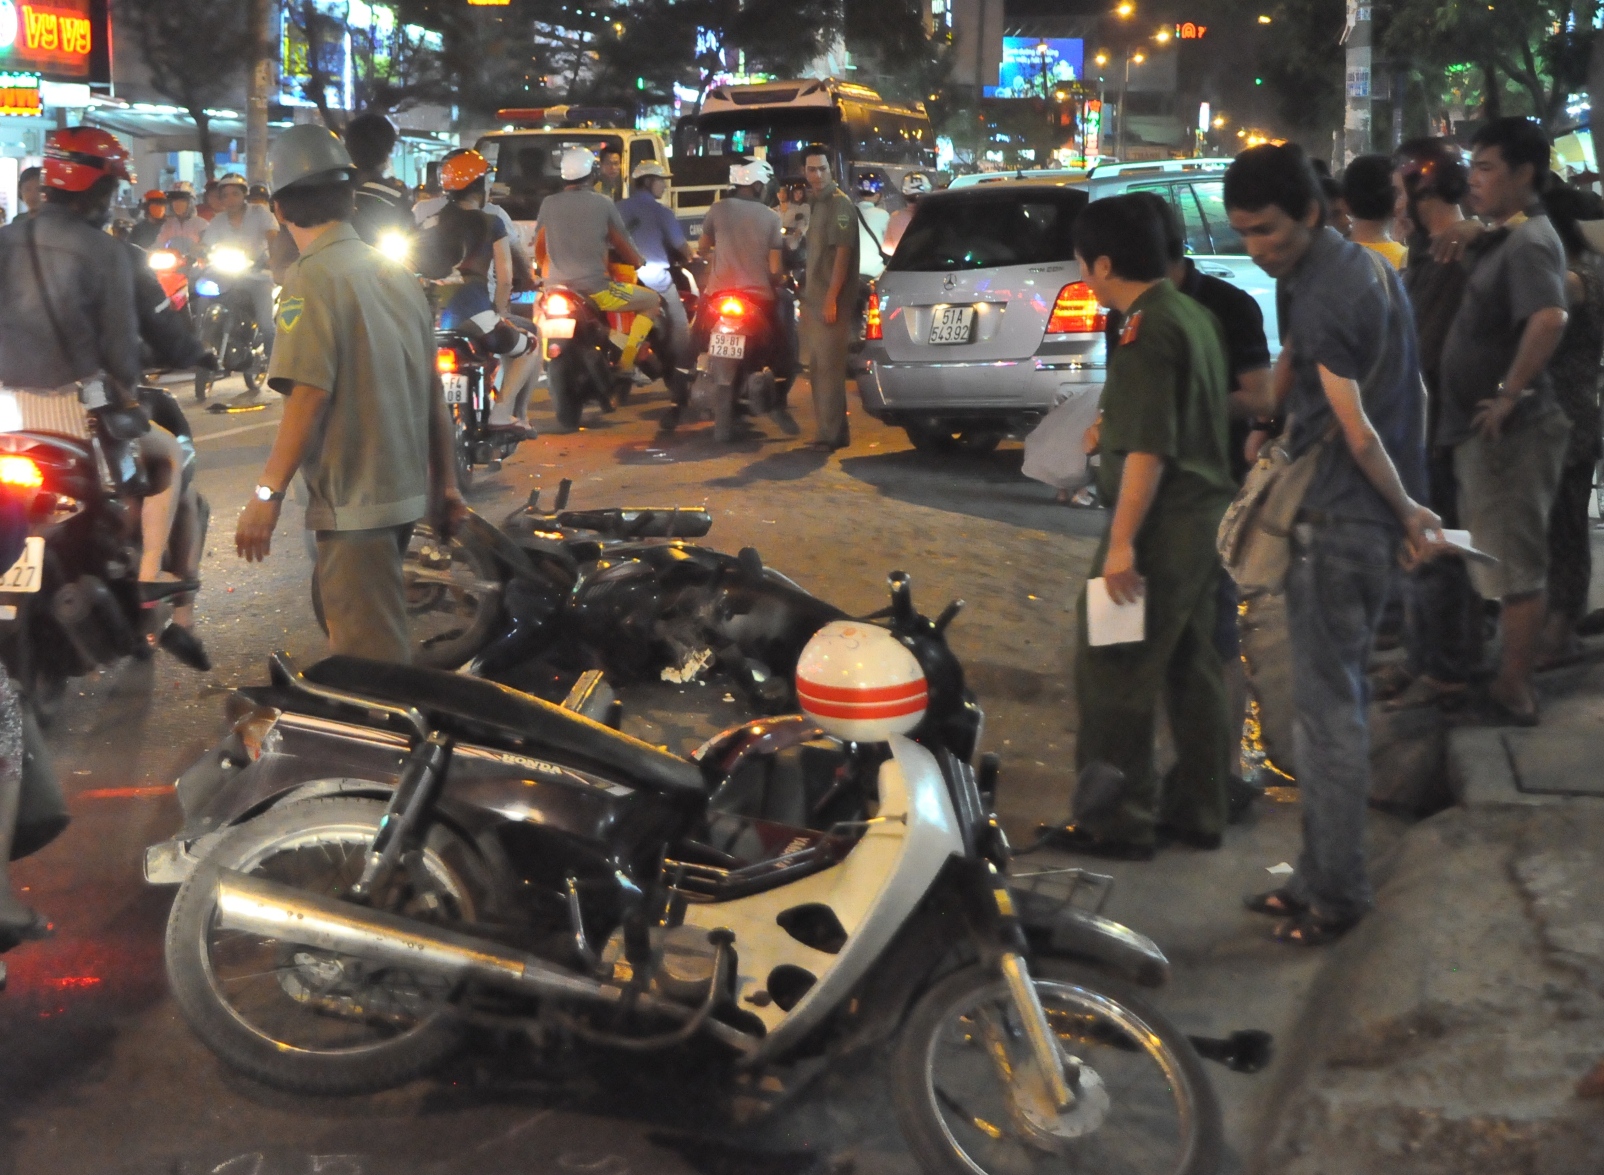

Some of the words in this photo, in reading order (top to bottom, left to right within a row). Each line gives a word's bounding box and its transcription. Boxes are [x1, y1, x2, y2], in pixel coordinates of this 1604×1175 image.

[942, 309, 963, 325] 51A
[930, 325, 969, 342] 543.92
[502, 754, 563, 775] HONDA
